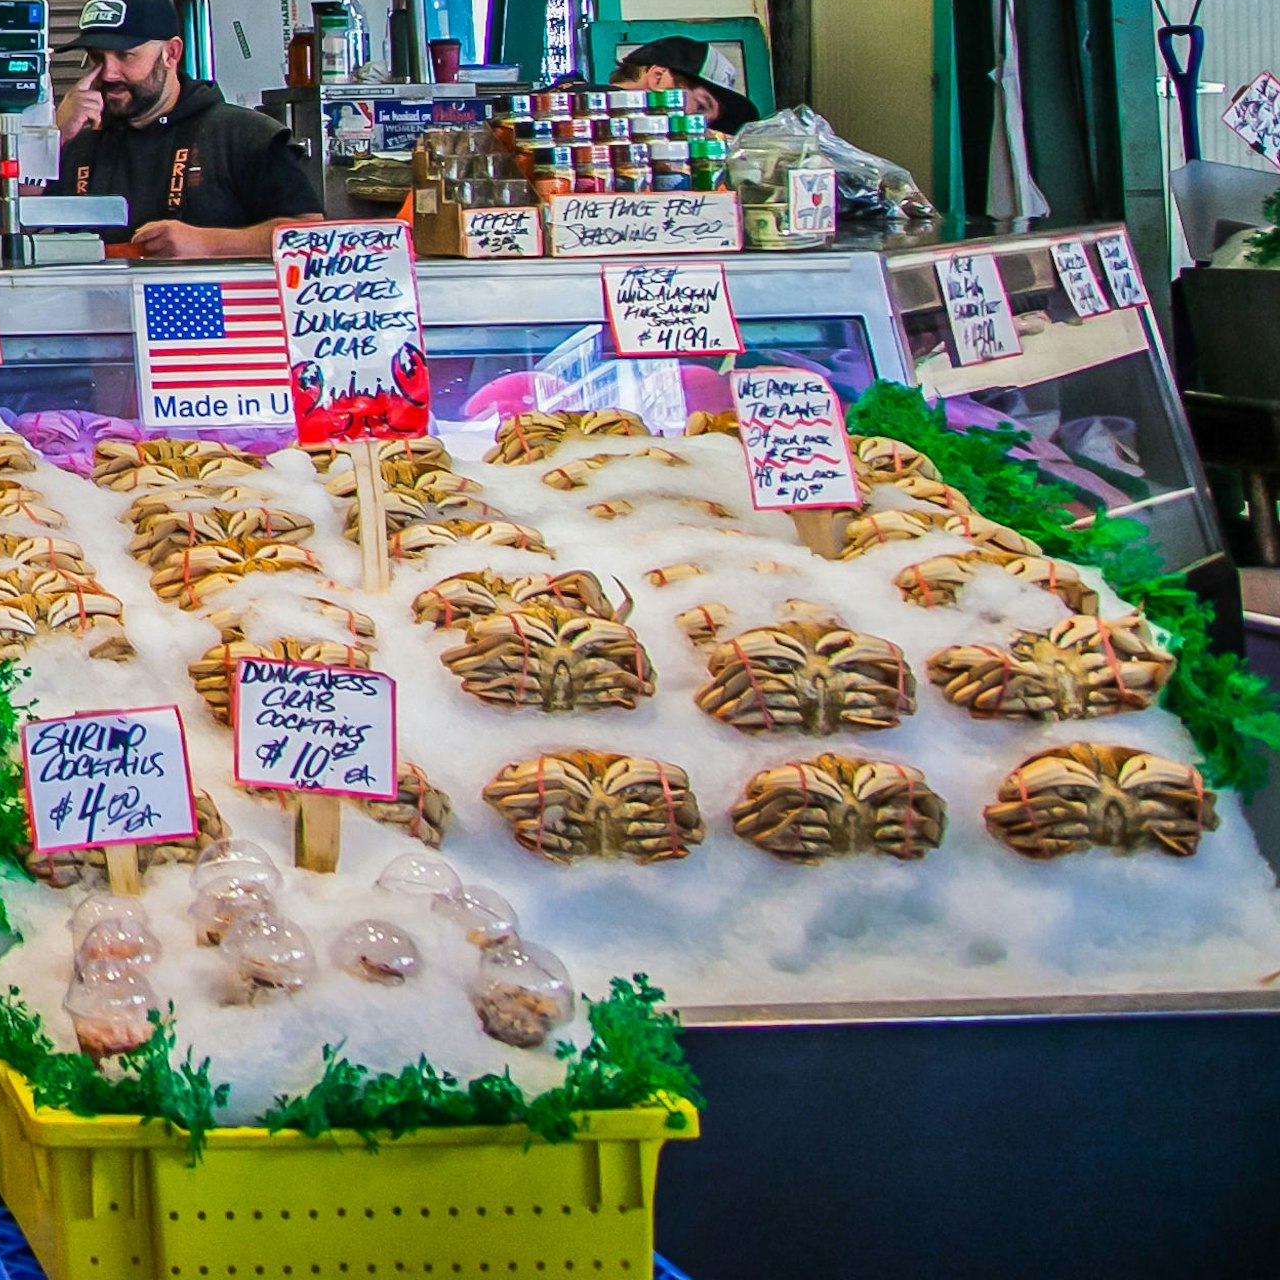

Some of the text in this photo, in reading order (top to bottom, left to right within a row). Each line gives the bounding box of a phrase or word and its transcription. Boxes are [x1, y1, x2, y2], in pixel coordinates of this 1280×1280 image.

[15, 82, 37, 90] CAS
[662, 196, 718, 217] FISH
[303, 254, 388, 280] WHOLE
[297, 277, 404, 305] COOKED
[291, 309, 418, 338] DUNGENESS
[314, 336, 378, 360] CRAB
[738, 374, 765, 399] WE
[154, 394, 260, 418] Made in
[240, 660, 379, 697] DUNGENESS
[261, 686, 335, 715] CRAB
[30, 720, 147, 758] SHRIMP
[256, 710, 373, 744] COCKTAILS
[40, 750, 165, 783] COCKTAILS
